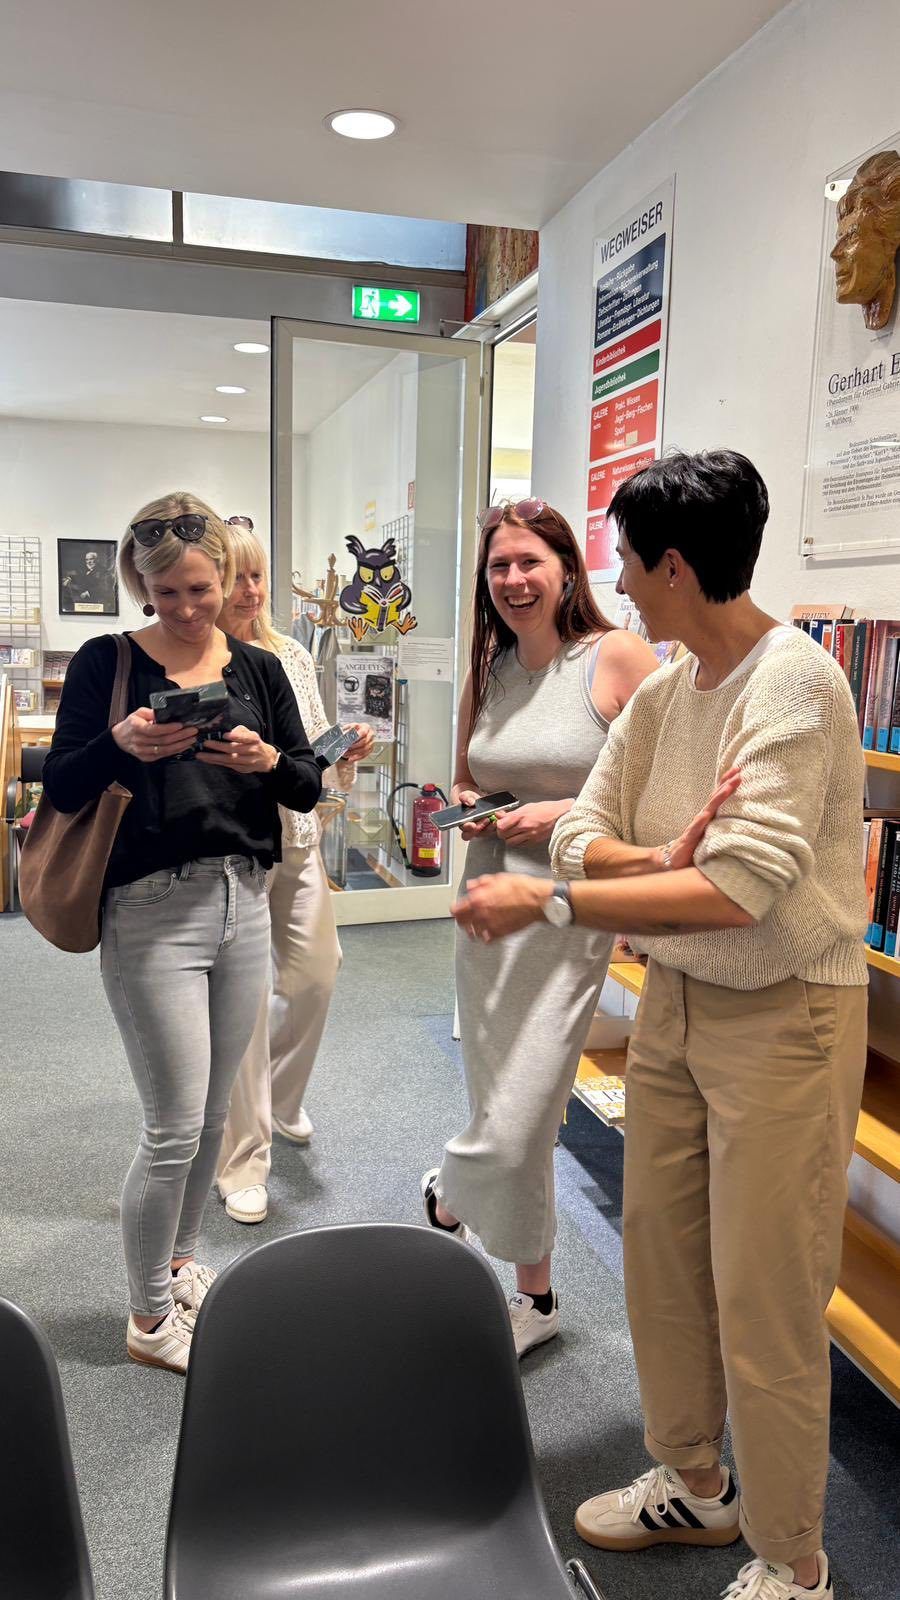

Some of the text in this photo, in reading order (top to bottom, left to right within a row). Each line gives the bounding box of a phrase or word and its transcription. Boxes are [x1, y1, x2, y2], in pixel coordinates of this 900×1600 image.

[600, 201, 663, 264] WEGWEISER
[828, 360, 883, 394] Gerhart
[367, 663, 386, 672] EYES
